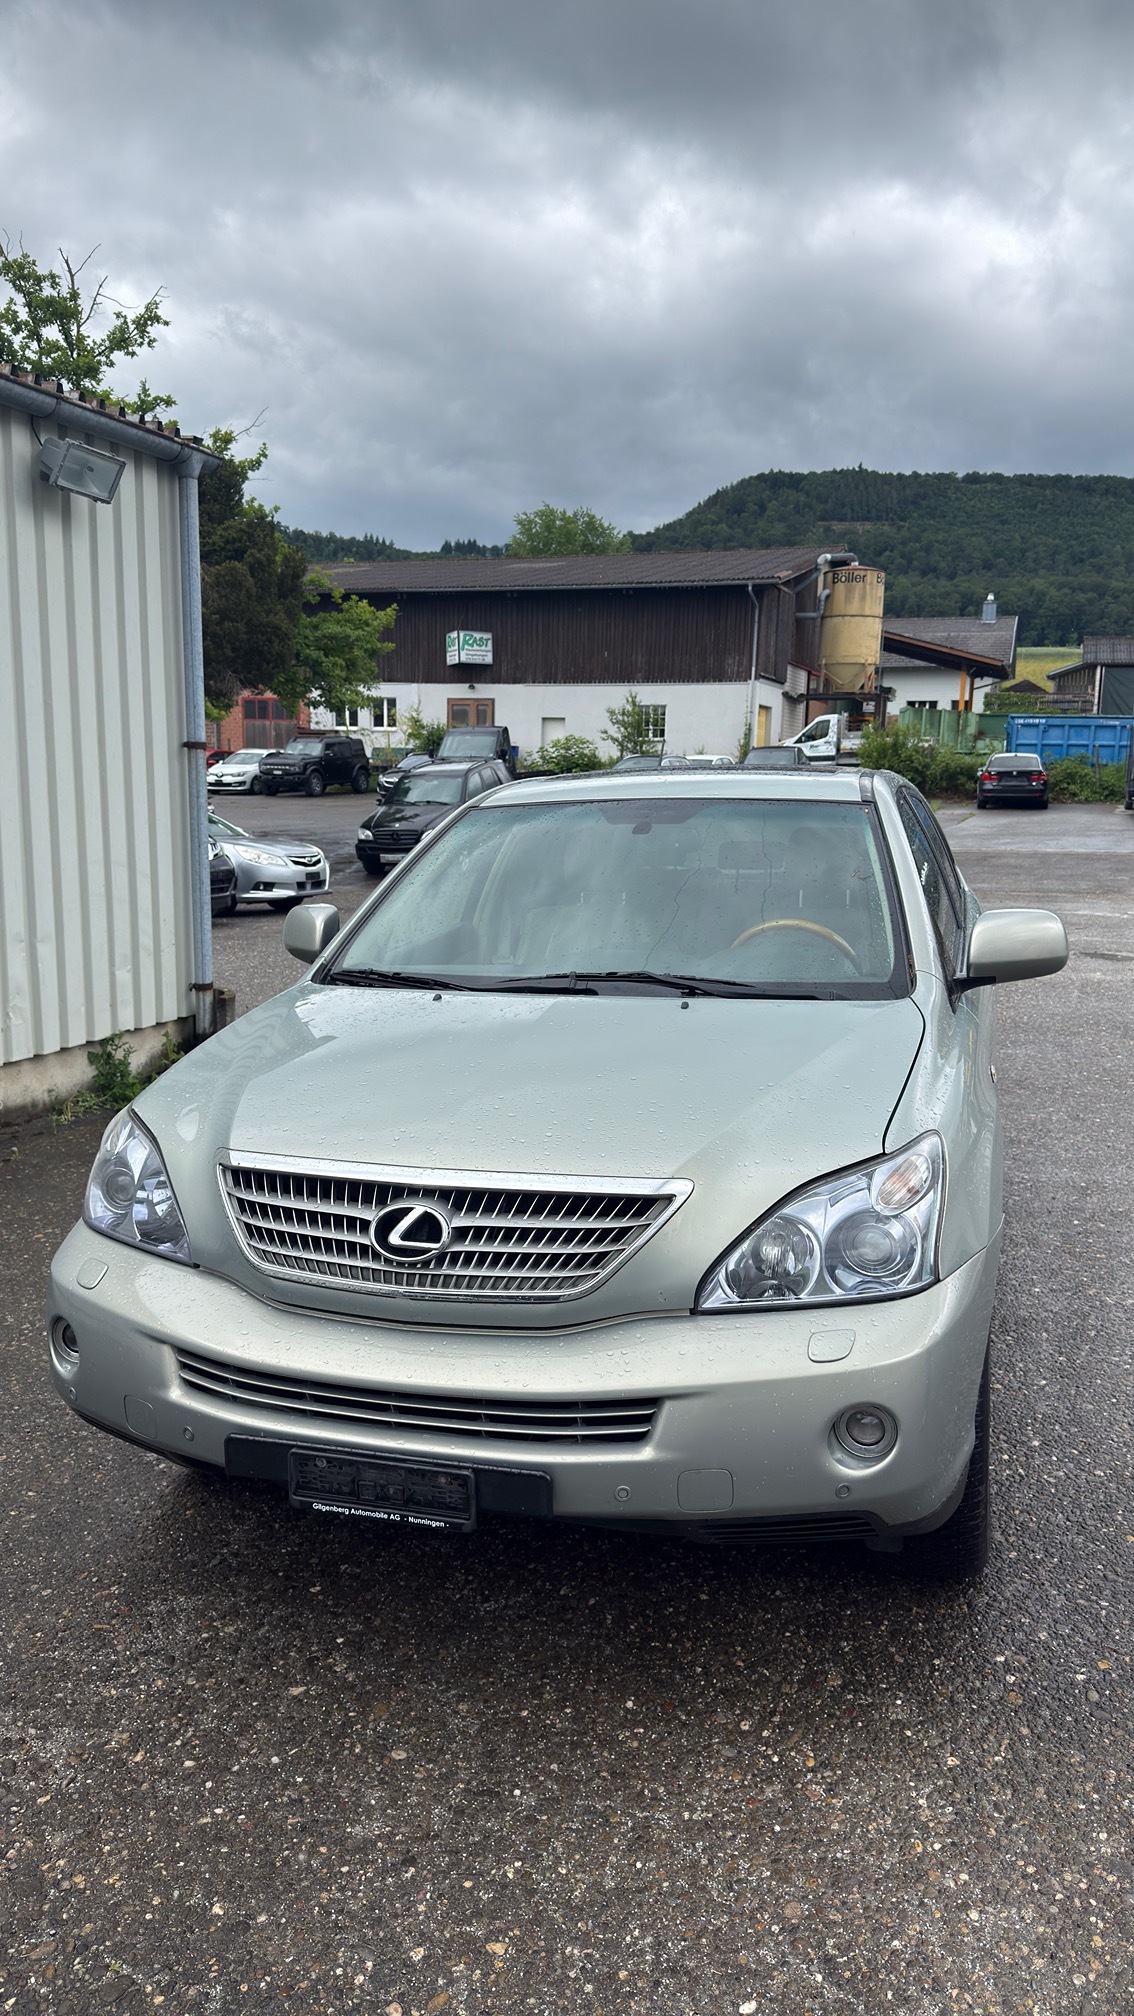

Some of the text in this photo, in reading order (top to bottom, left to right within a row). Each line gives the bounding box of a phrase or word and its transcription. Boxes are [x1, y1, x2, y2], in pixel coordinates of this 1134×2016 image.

[832, 571, 867, 584] Böller
[312, 1503, 349, 1515] Gilgenberg
[350, 1508, 388, 1520] Automobile
[389, 1513, 401, 1521] AG
[408, 1516, 445, 1528] Nunningen
